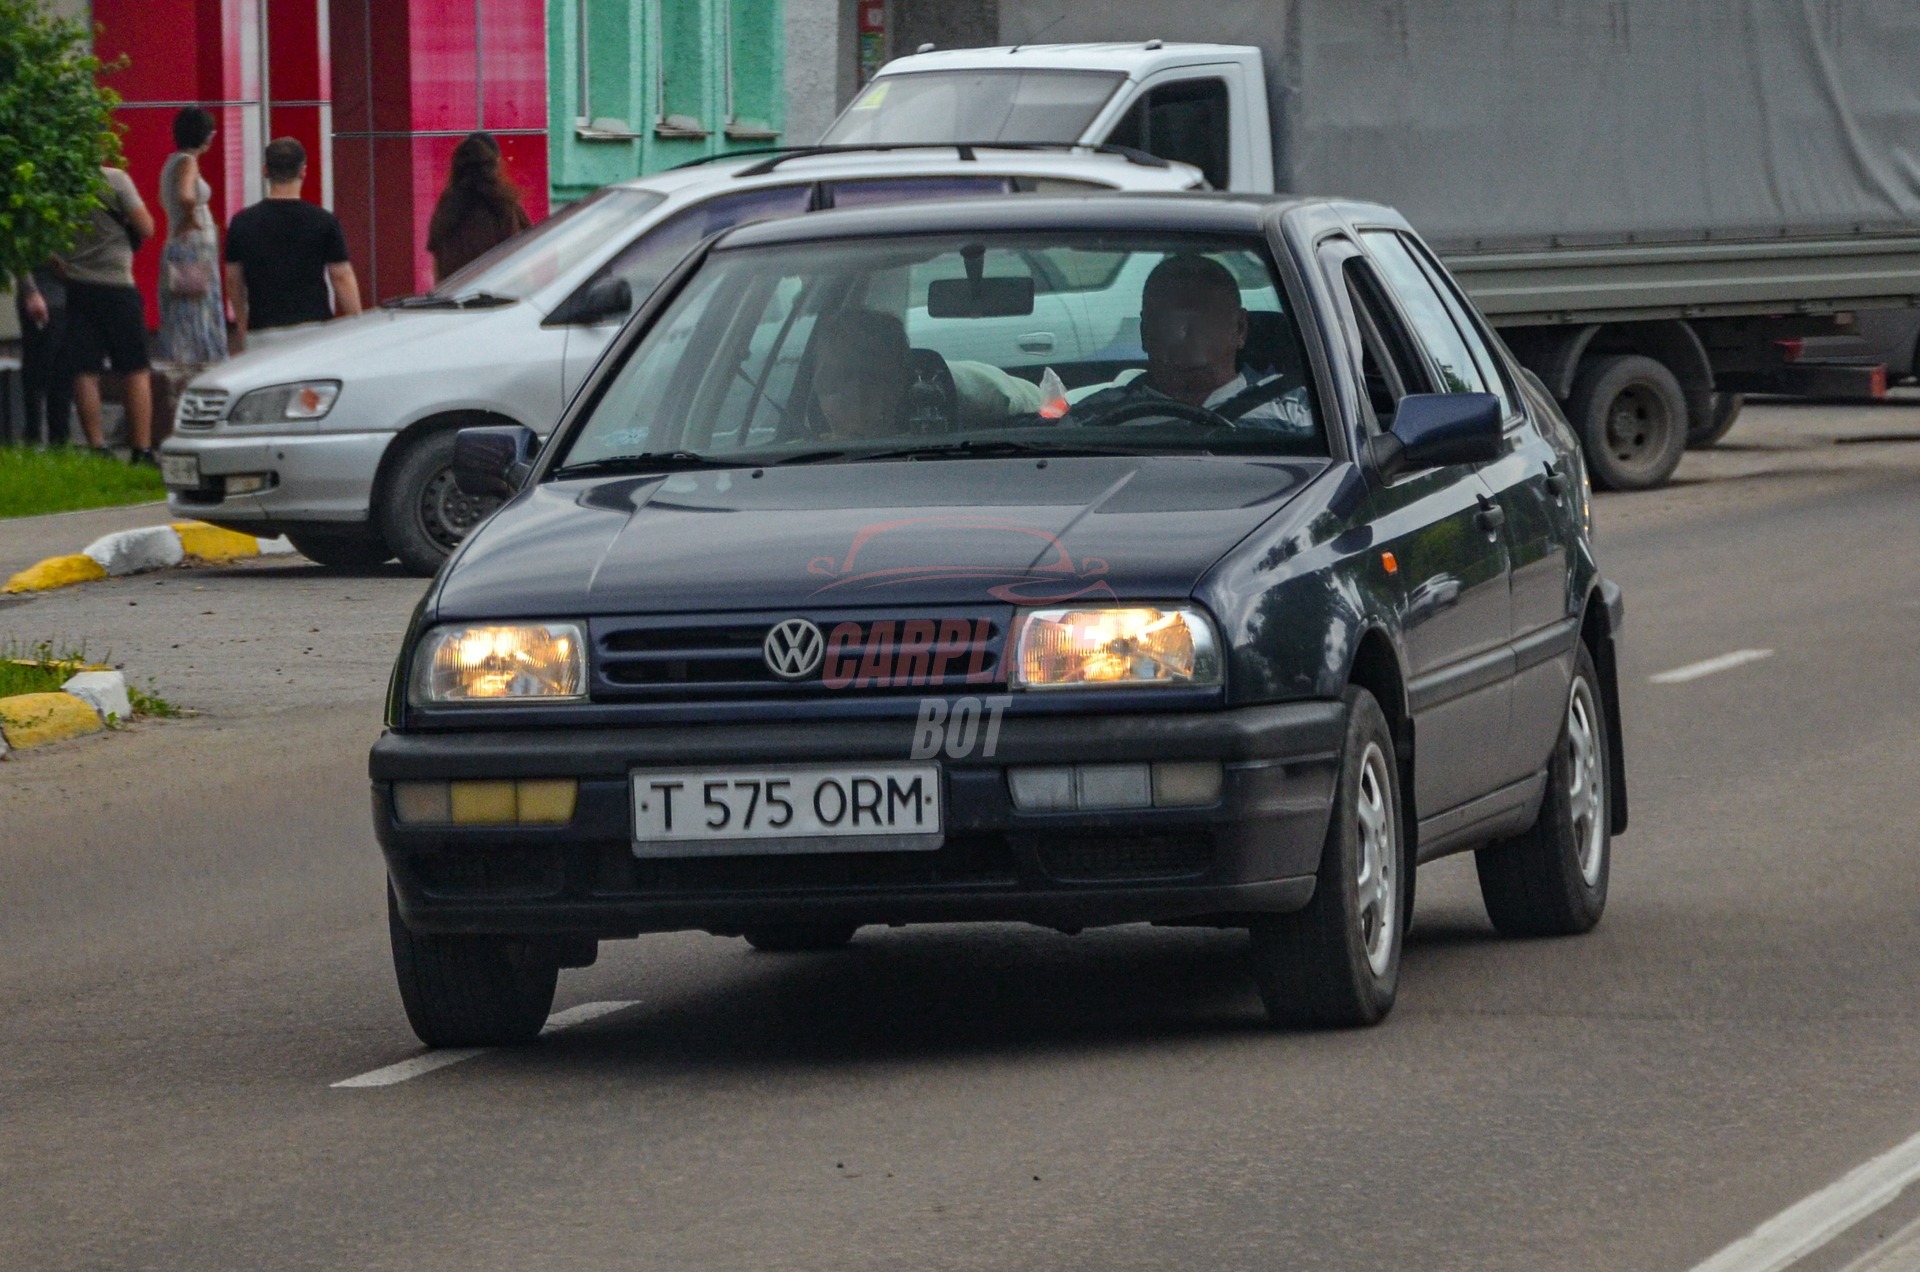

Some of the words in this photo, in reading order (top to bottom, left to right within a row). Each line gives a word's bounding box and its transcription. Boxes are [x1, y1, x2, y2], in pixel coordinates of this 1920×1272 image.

[764, 618, 824, 678] VW
[650, 780, 684, 832] T
[703, 778, 794, 830] 575
[813, 774, 923, 827] ORM
